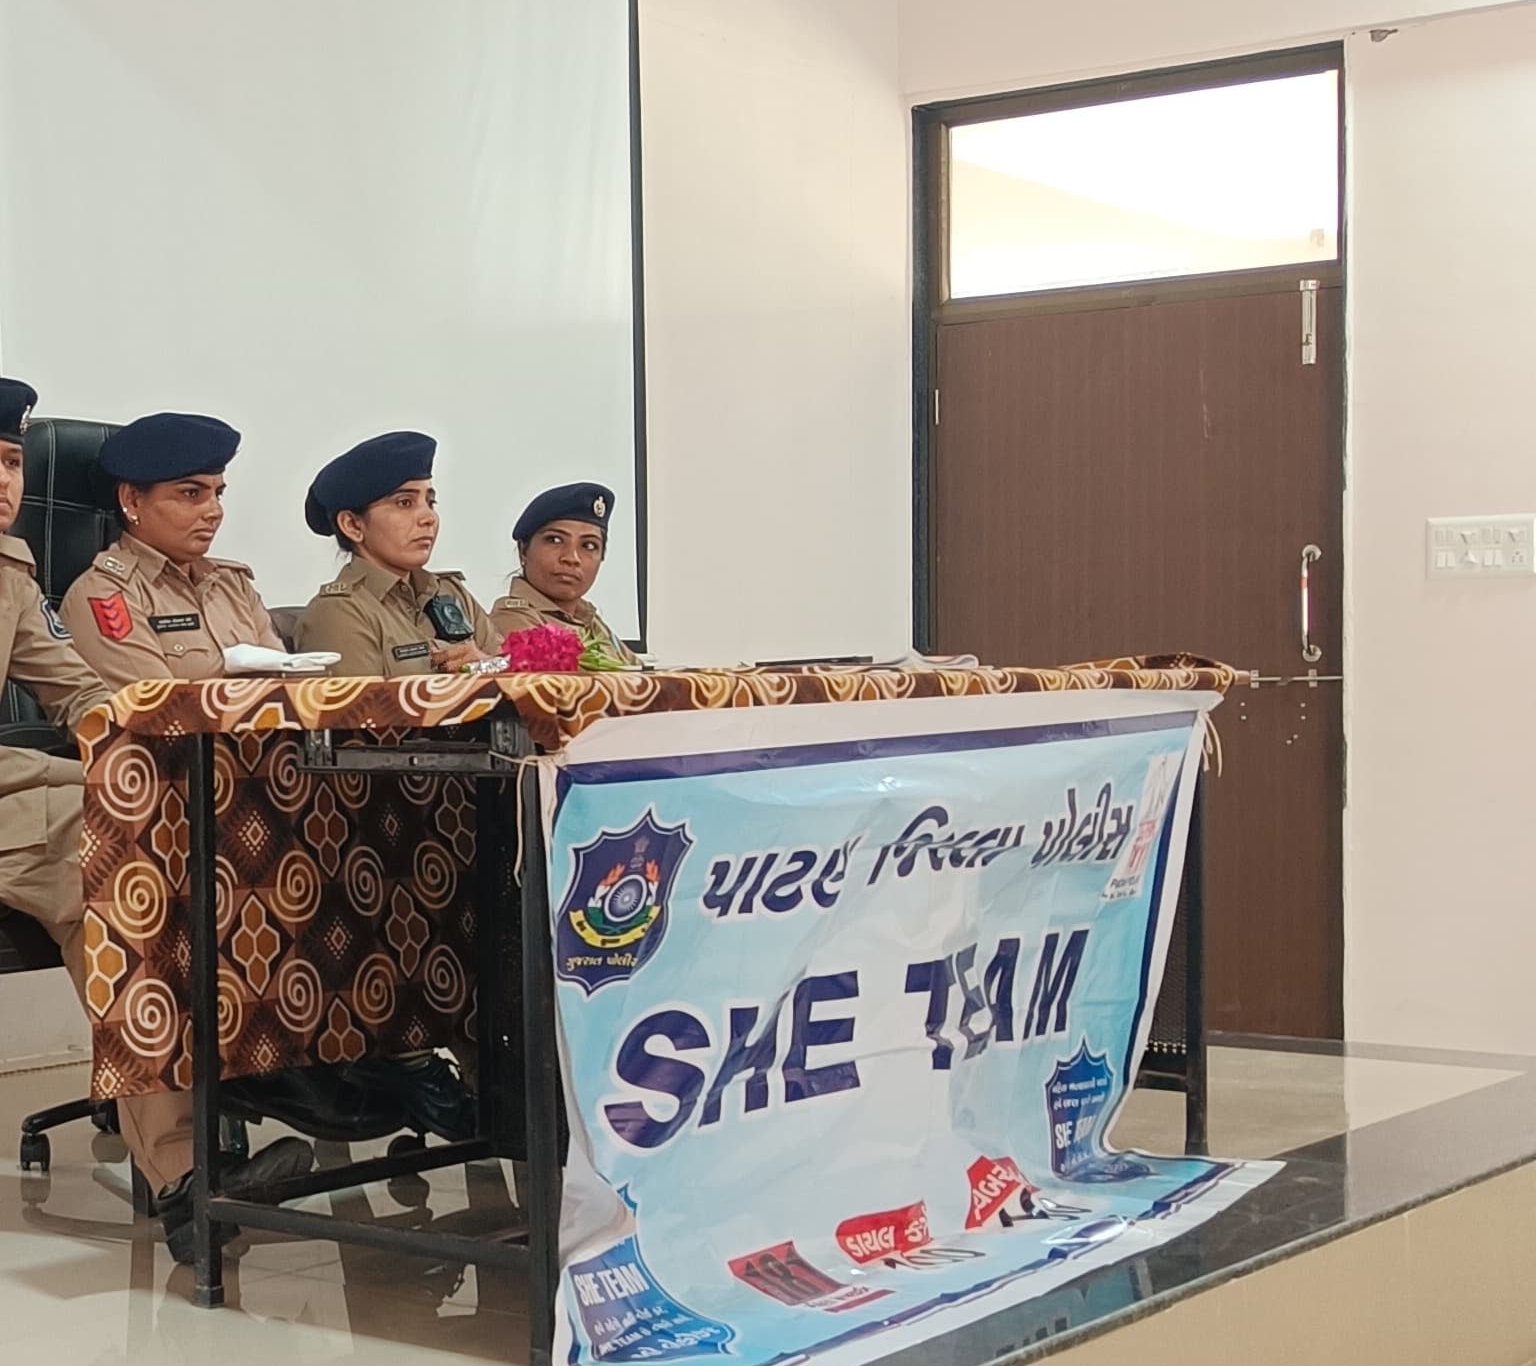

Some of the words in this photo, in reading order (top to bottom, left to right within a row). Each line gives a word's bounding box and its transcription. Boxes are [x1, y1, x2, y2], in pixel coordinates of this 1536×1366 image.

[603, 970, 861, 1149] SHE
[904, 930, 1090, 1071] TEAM
[574, 1273, 606, 1307] SHE
[596, 1262, 650, 1301] TEAM
